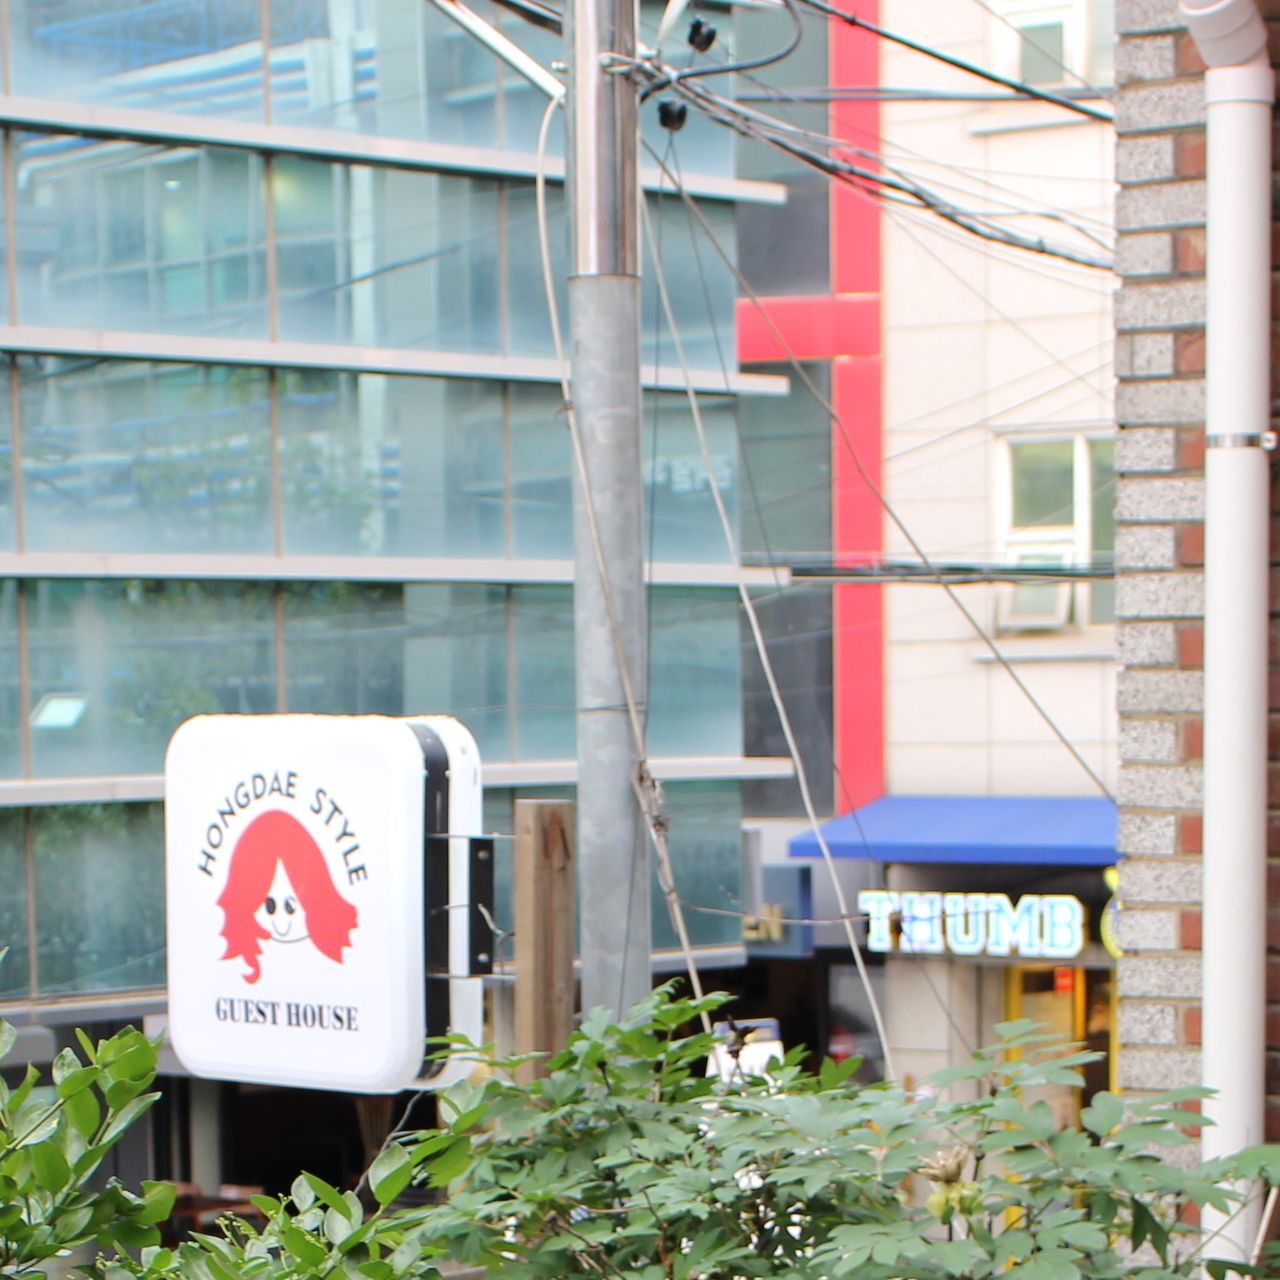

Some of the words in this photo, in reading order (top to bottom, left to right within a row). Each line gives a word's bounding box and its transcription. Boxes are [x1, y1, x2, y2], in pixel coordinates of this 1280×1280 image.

[197, 770, 299, 879] HONGDAE
[310, 787, 368, 886] STYLE
[858, 890, 1084, 958] THUMB
[215, 997, 281, 1027] GUEST
[286, 1003, 359, 1032] HOUSE
